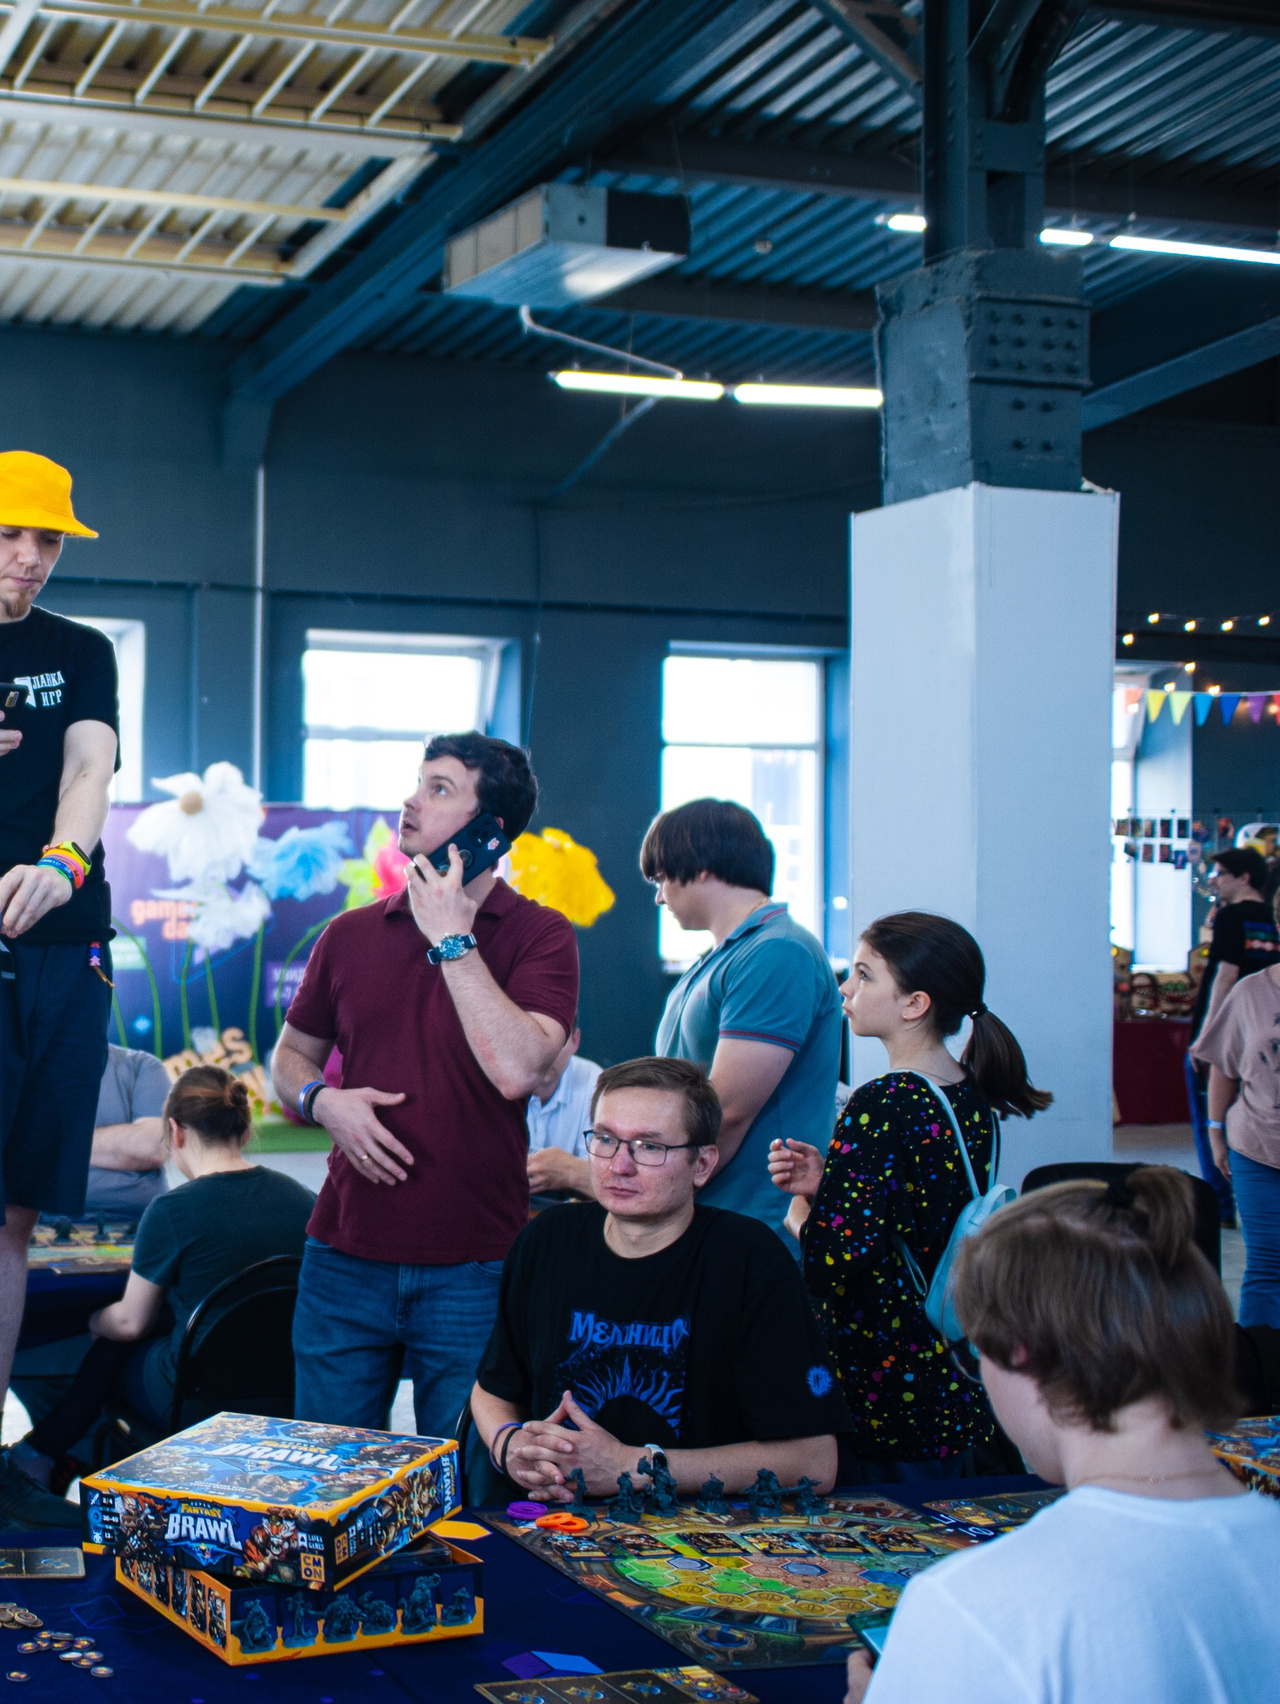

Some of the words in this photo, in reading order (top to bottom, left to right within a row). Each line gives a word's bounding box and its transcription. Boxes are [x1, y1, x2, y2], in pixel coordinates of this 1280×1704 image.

[32, 671, 65, 689] ЛАВКА
[41, 689, 62, 706] ИГР
[202, 1442, 339, 1472] BRAWL
[441, 1455, 452, 1516] BRAWL
[181, 1503, 222, 1519] FANTASY
[164, 1513, 243, 1551] BRAWL
